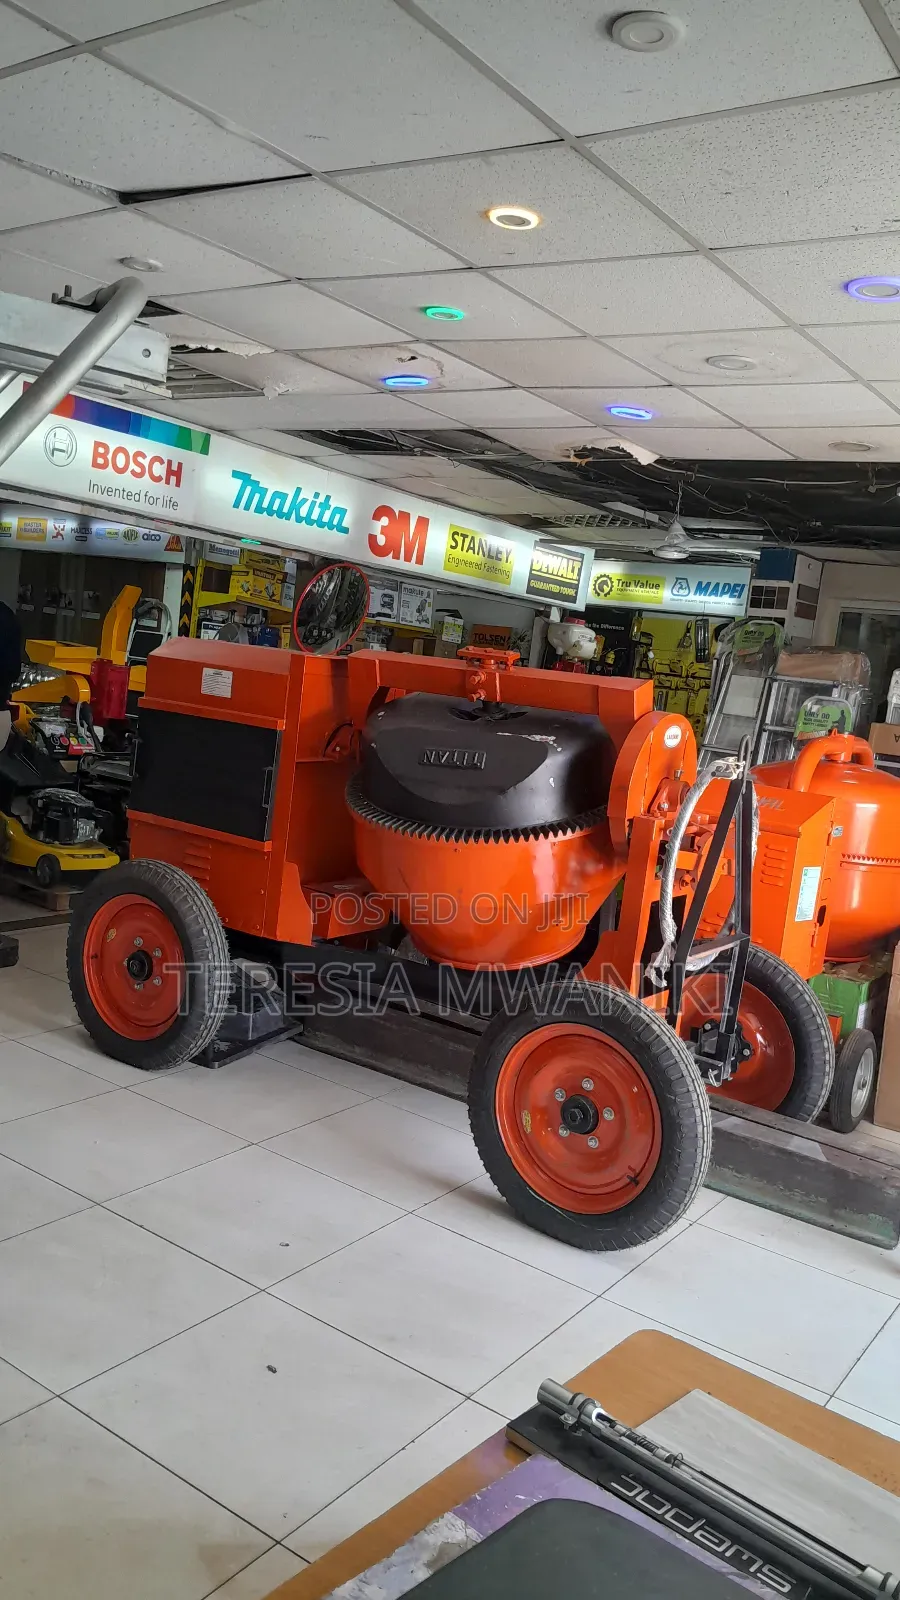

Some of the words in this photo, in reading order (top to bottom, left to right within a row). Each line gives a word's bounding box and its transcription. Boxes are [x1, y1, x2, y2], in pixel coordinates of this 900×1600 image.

[91, 440, 183, 488] BOSCH
[88, 479, 141, 503] Invented
[143, 493, 162, 507] for
[162, 495, 179, 511] life
[367, 504, 430, 566] 3M
[449, 530, 512, 564] STANLEY
[447, 553, 482, 571] Engineered
[483, 562, 510, 580] Fastening
[616, 578, 633, 588] Tru
[633, 579, 660, 590] Value
[693, 580, 746, 599] MAPEI
[473, 632, 506, 643] TOLSEN
[422, 749, 487, 770] TITAN
[609, 1473, 797, 1594] swepac
